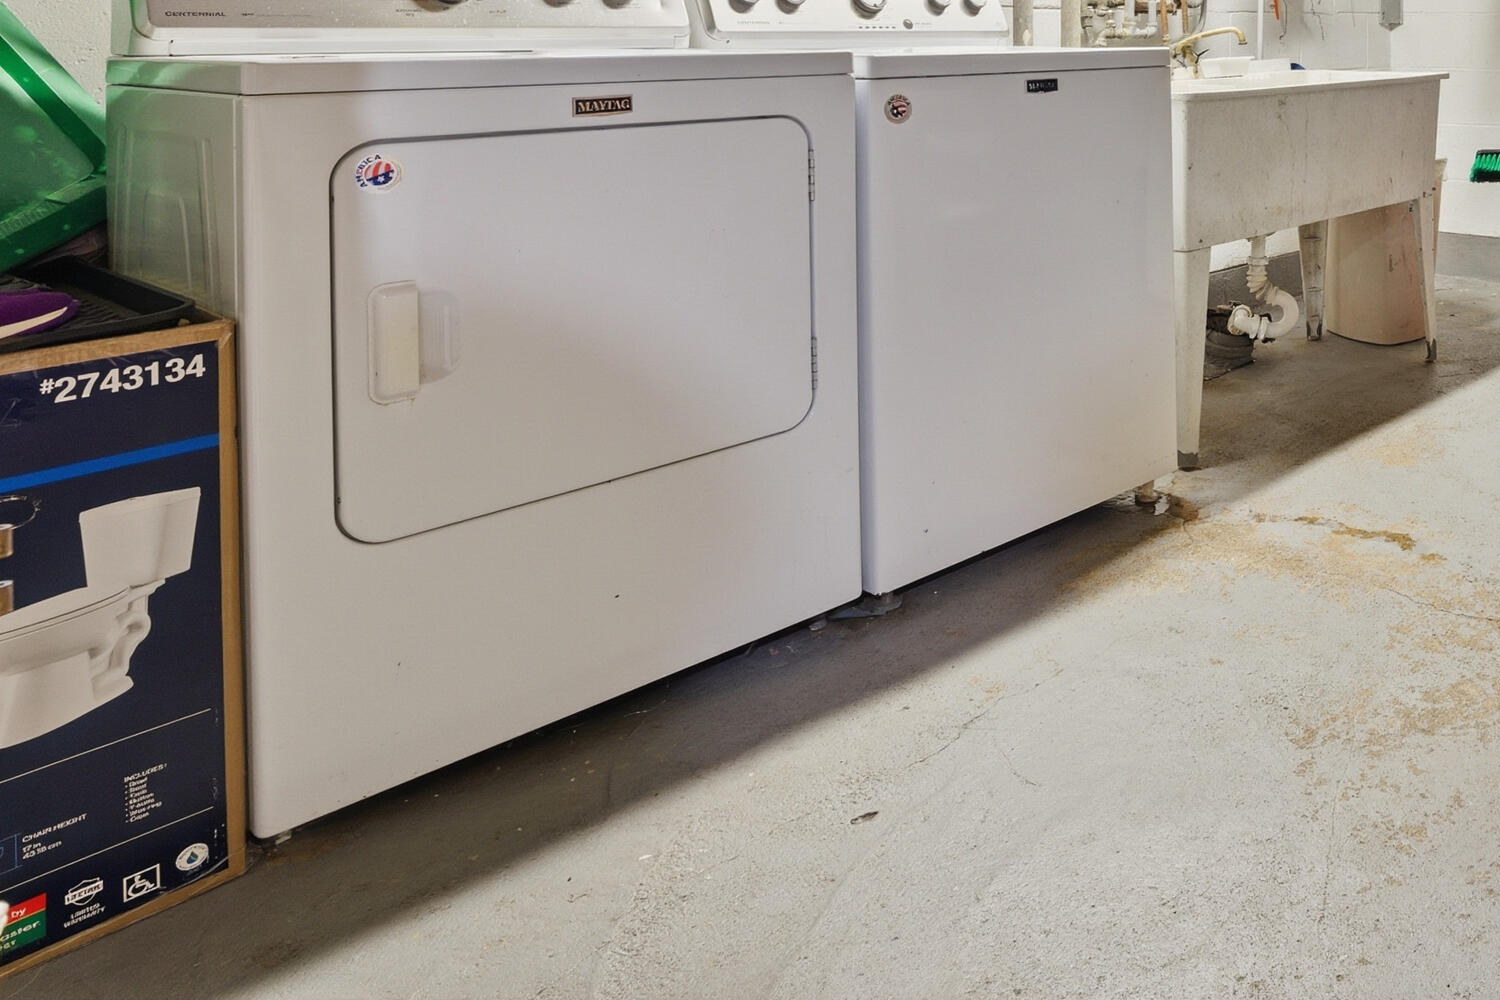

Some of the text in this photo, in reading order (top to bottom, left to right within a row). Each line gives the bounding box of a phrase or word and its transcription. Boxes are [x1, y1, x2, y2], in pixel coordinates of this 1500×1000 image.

[577, 99, 630, 113] MAYTAG
[39, 353, 206, 404] #2743134
[11, 908, 26, 919] by
